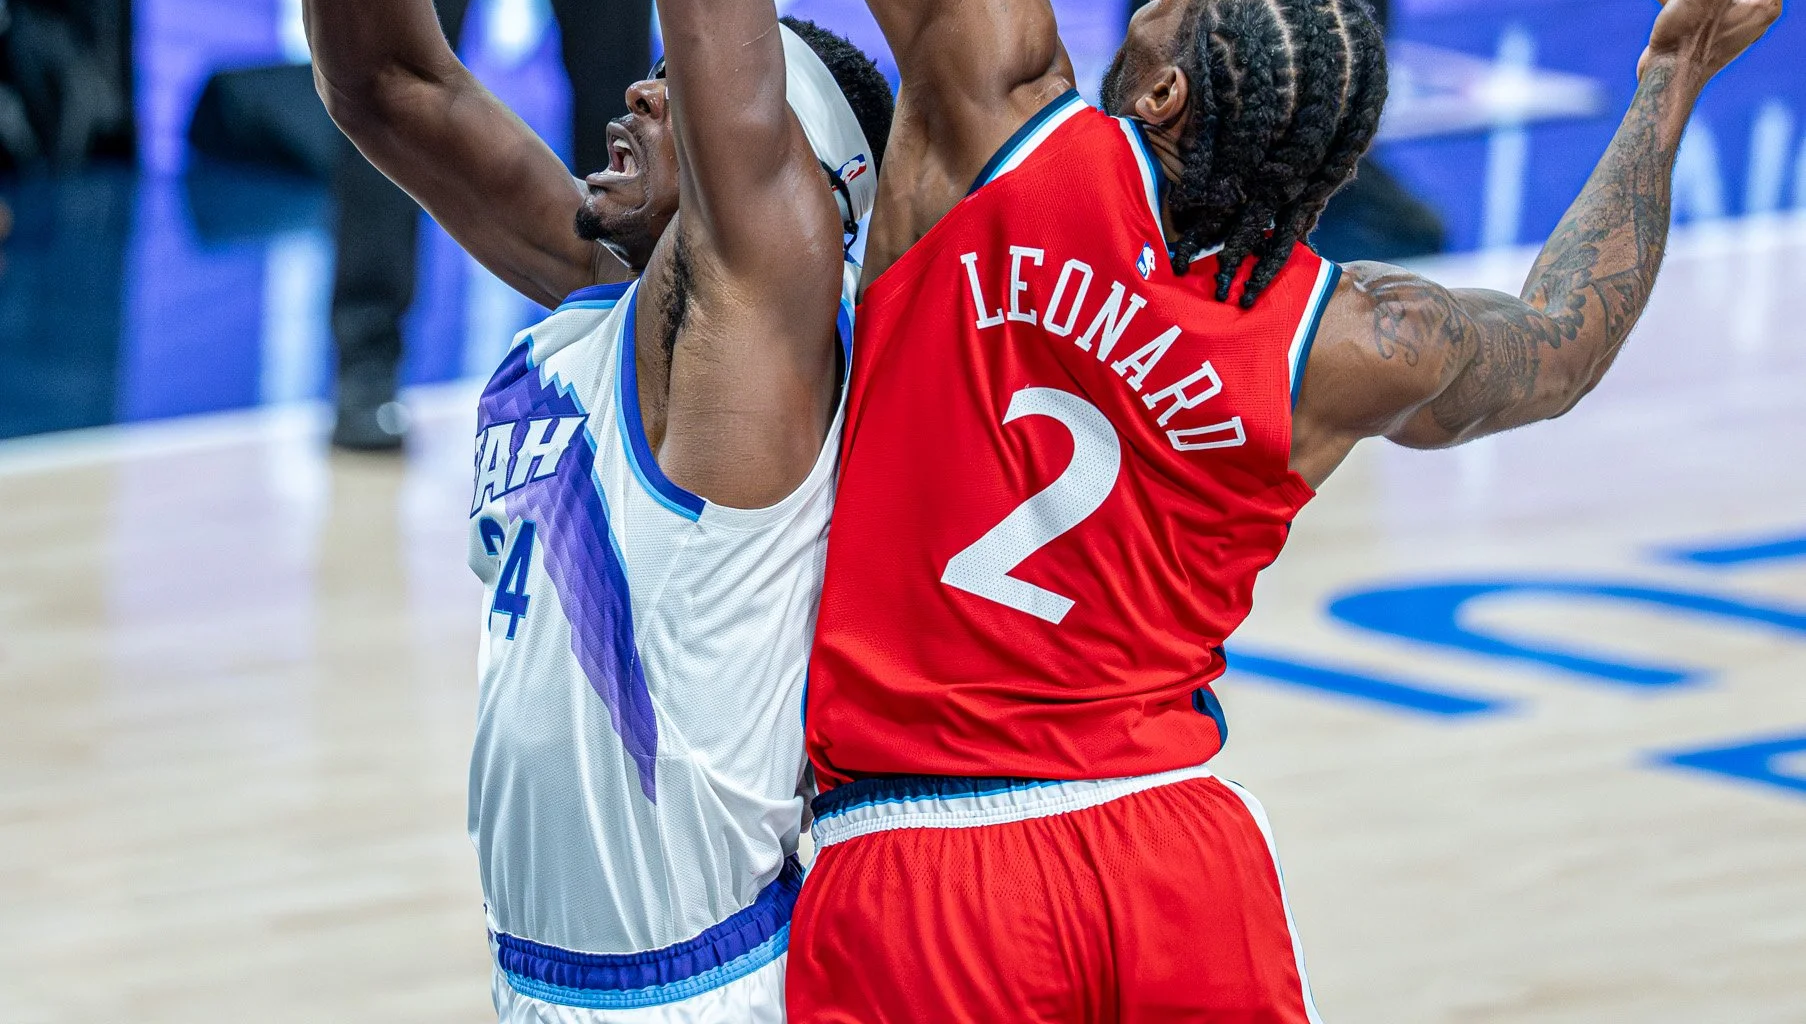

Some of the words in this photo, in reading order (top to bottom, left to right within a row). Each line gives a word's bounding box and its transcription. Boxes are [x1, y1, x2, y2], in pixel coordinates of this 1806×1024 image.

[960, 245, 1247, 452] LEONARD
[470, 413, 590, 519] AH
[940, 386, 1122, 626] 2
